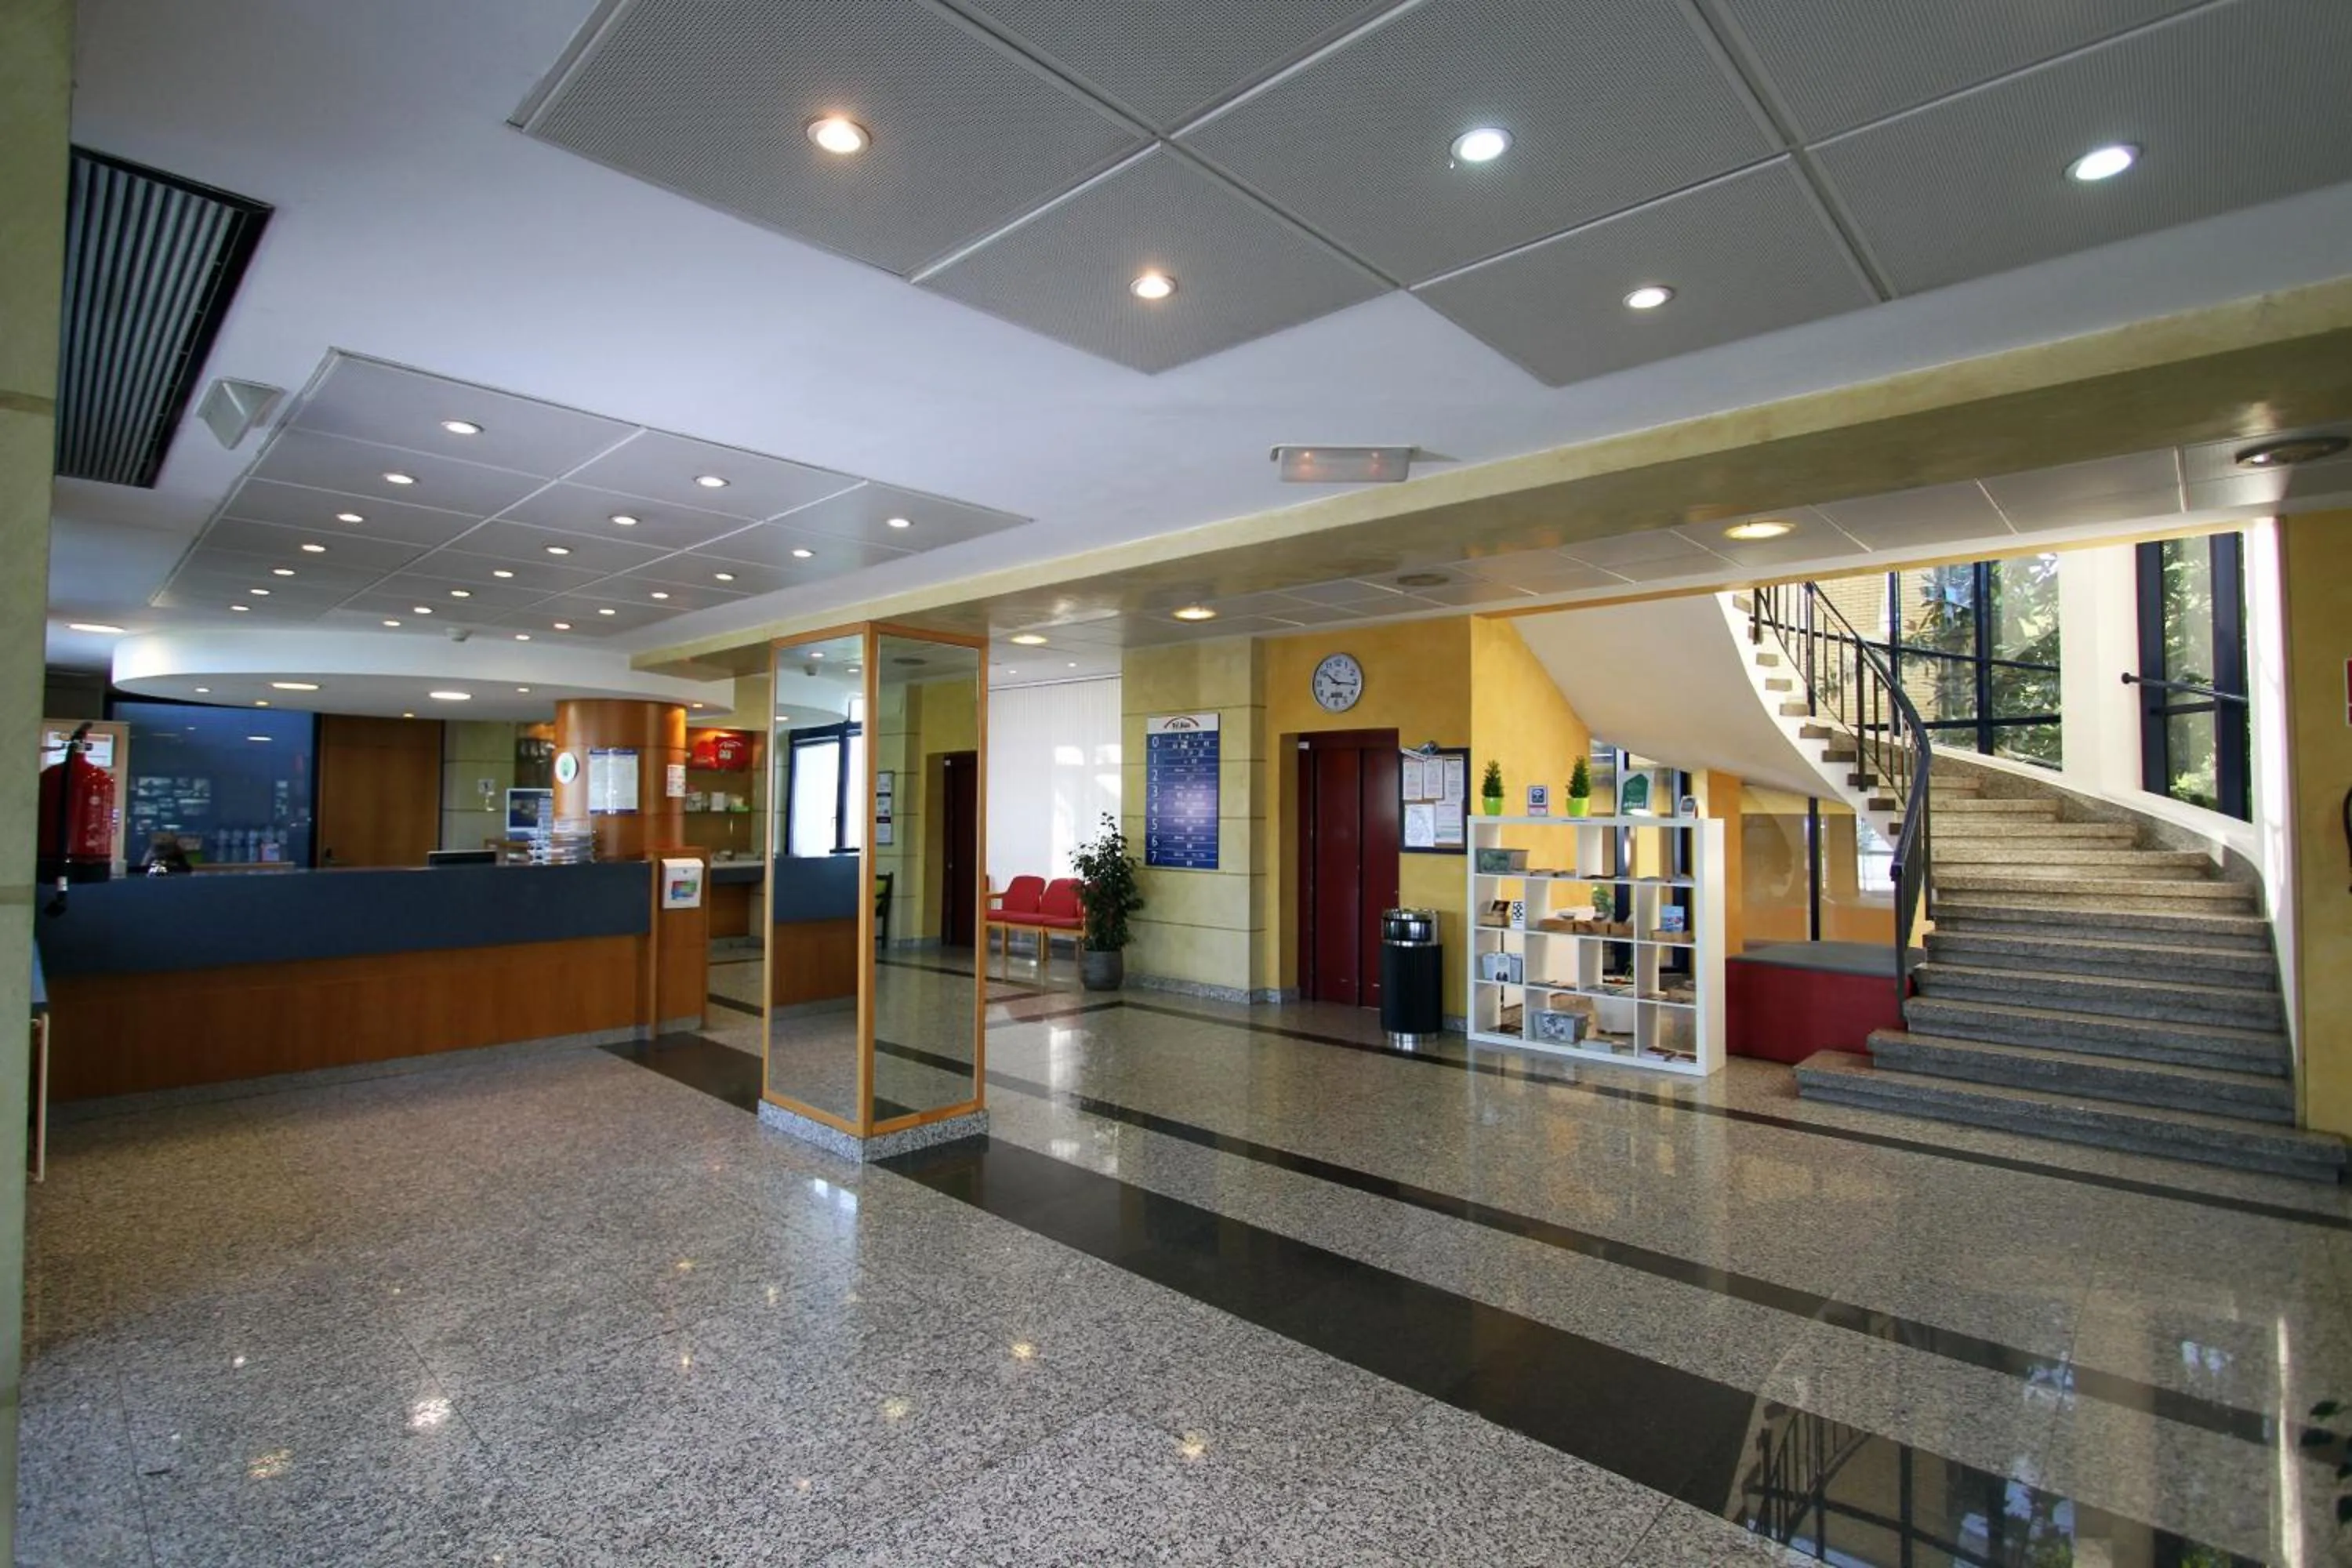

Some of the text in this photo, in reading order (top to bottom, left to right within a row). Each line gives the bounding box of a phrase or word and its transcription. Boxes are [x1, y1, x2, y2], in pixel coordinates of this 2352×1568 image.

[1152, 736, 1160, 748] 0
[1151, 769, 1158, 782] 2
[1151, 785, 1158, 797] 3
[1151, 802, 1158, 815] 4
[1151, 818, 1158, 830] 5
[1152, 835, 1158, 847] 6
[1151, 851, 1158, 863] 7
